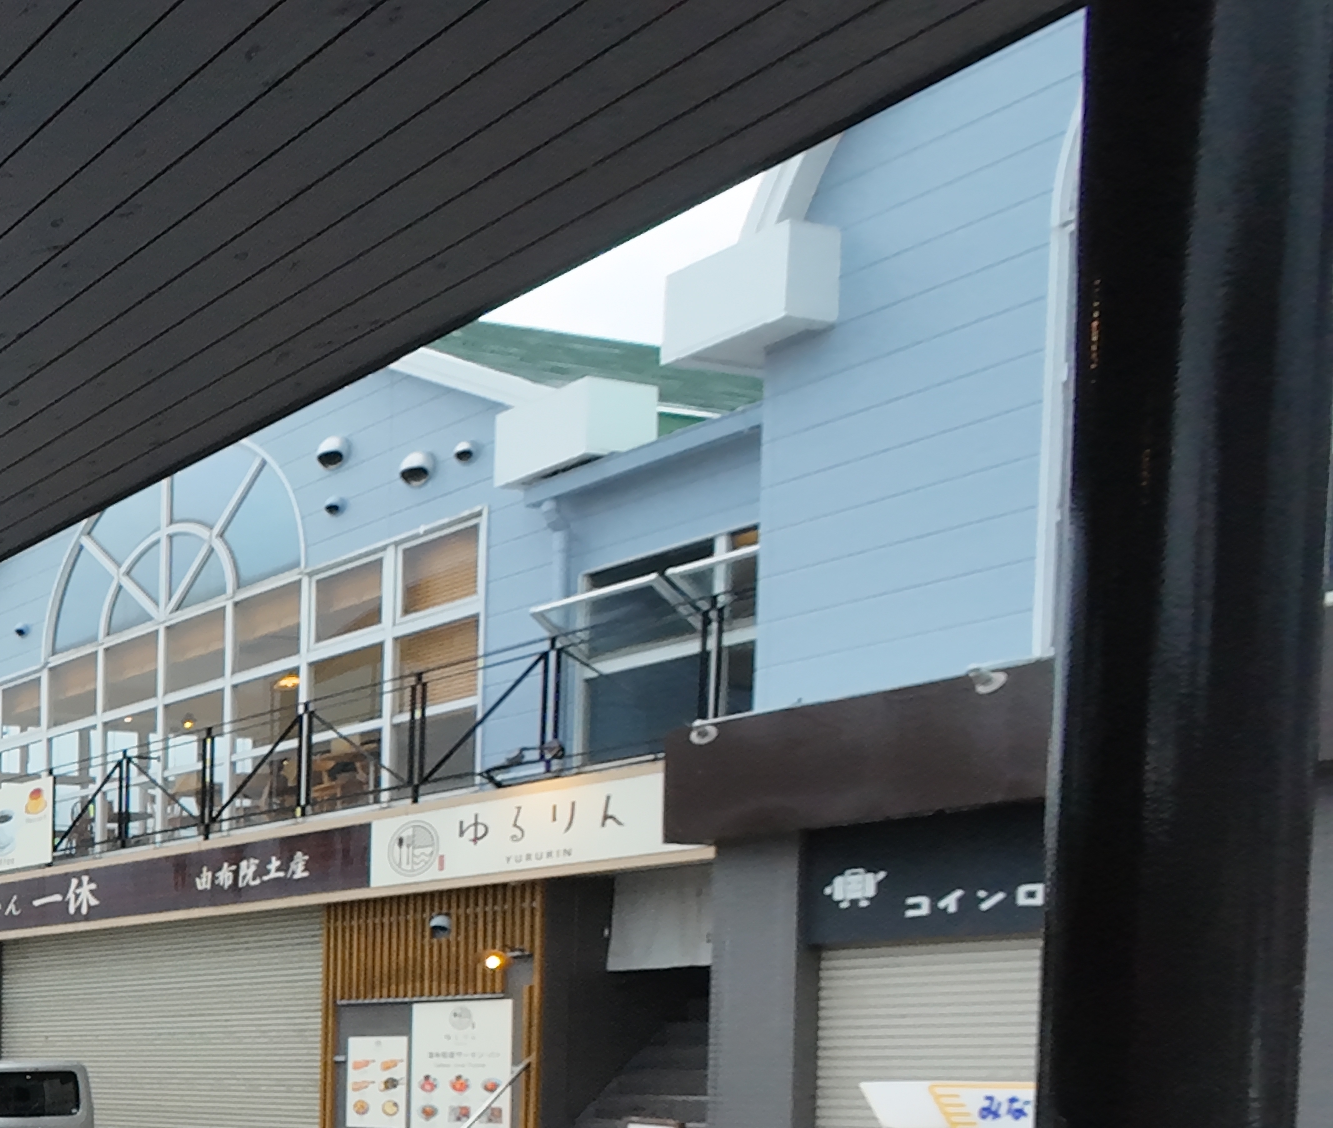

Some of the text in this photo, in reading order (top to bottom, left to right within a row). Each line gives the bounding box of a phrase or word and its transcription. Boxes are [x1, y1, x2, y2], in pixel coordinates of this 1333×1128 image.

[458, 794, 624, 845] ゆるりん
[505, 848, 573, 864] YURURIN
[32, 874, 100, 916] 一休
[195, 850, 311, 892] 由布院土産
